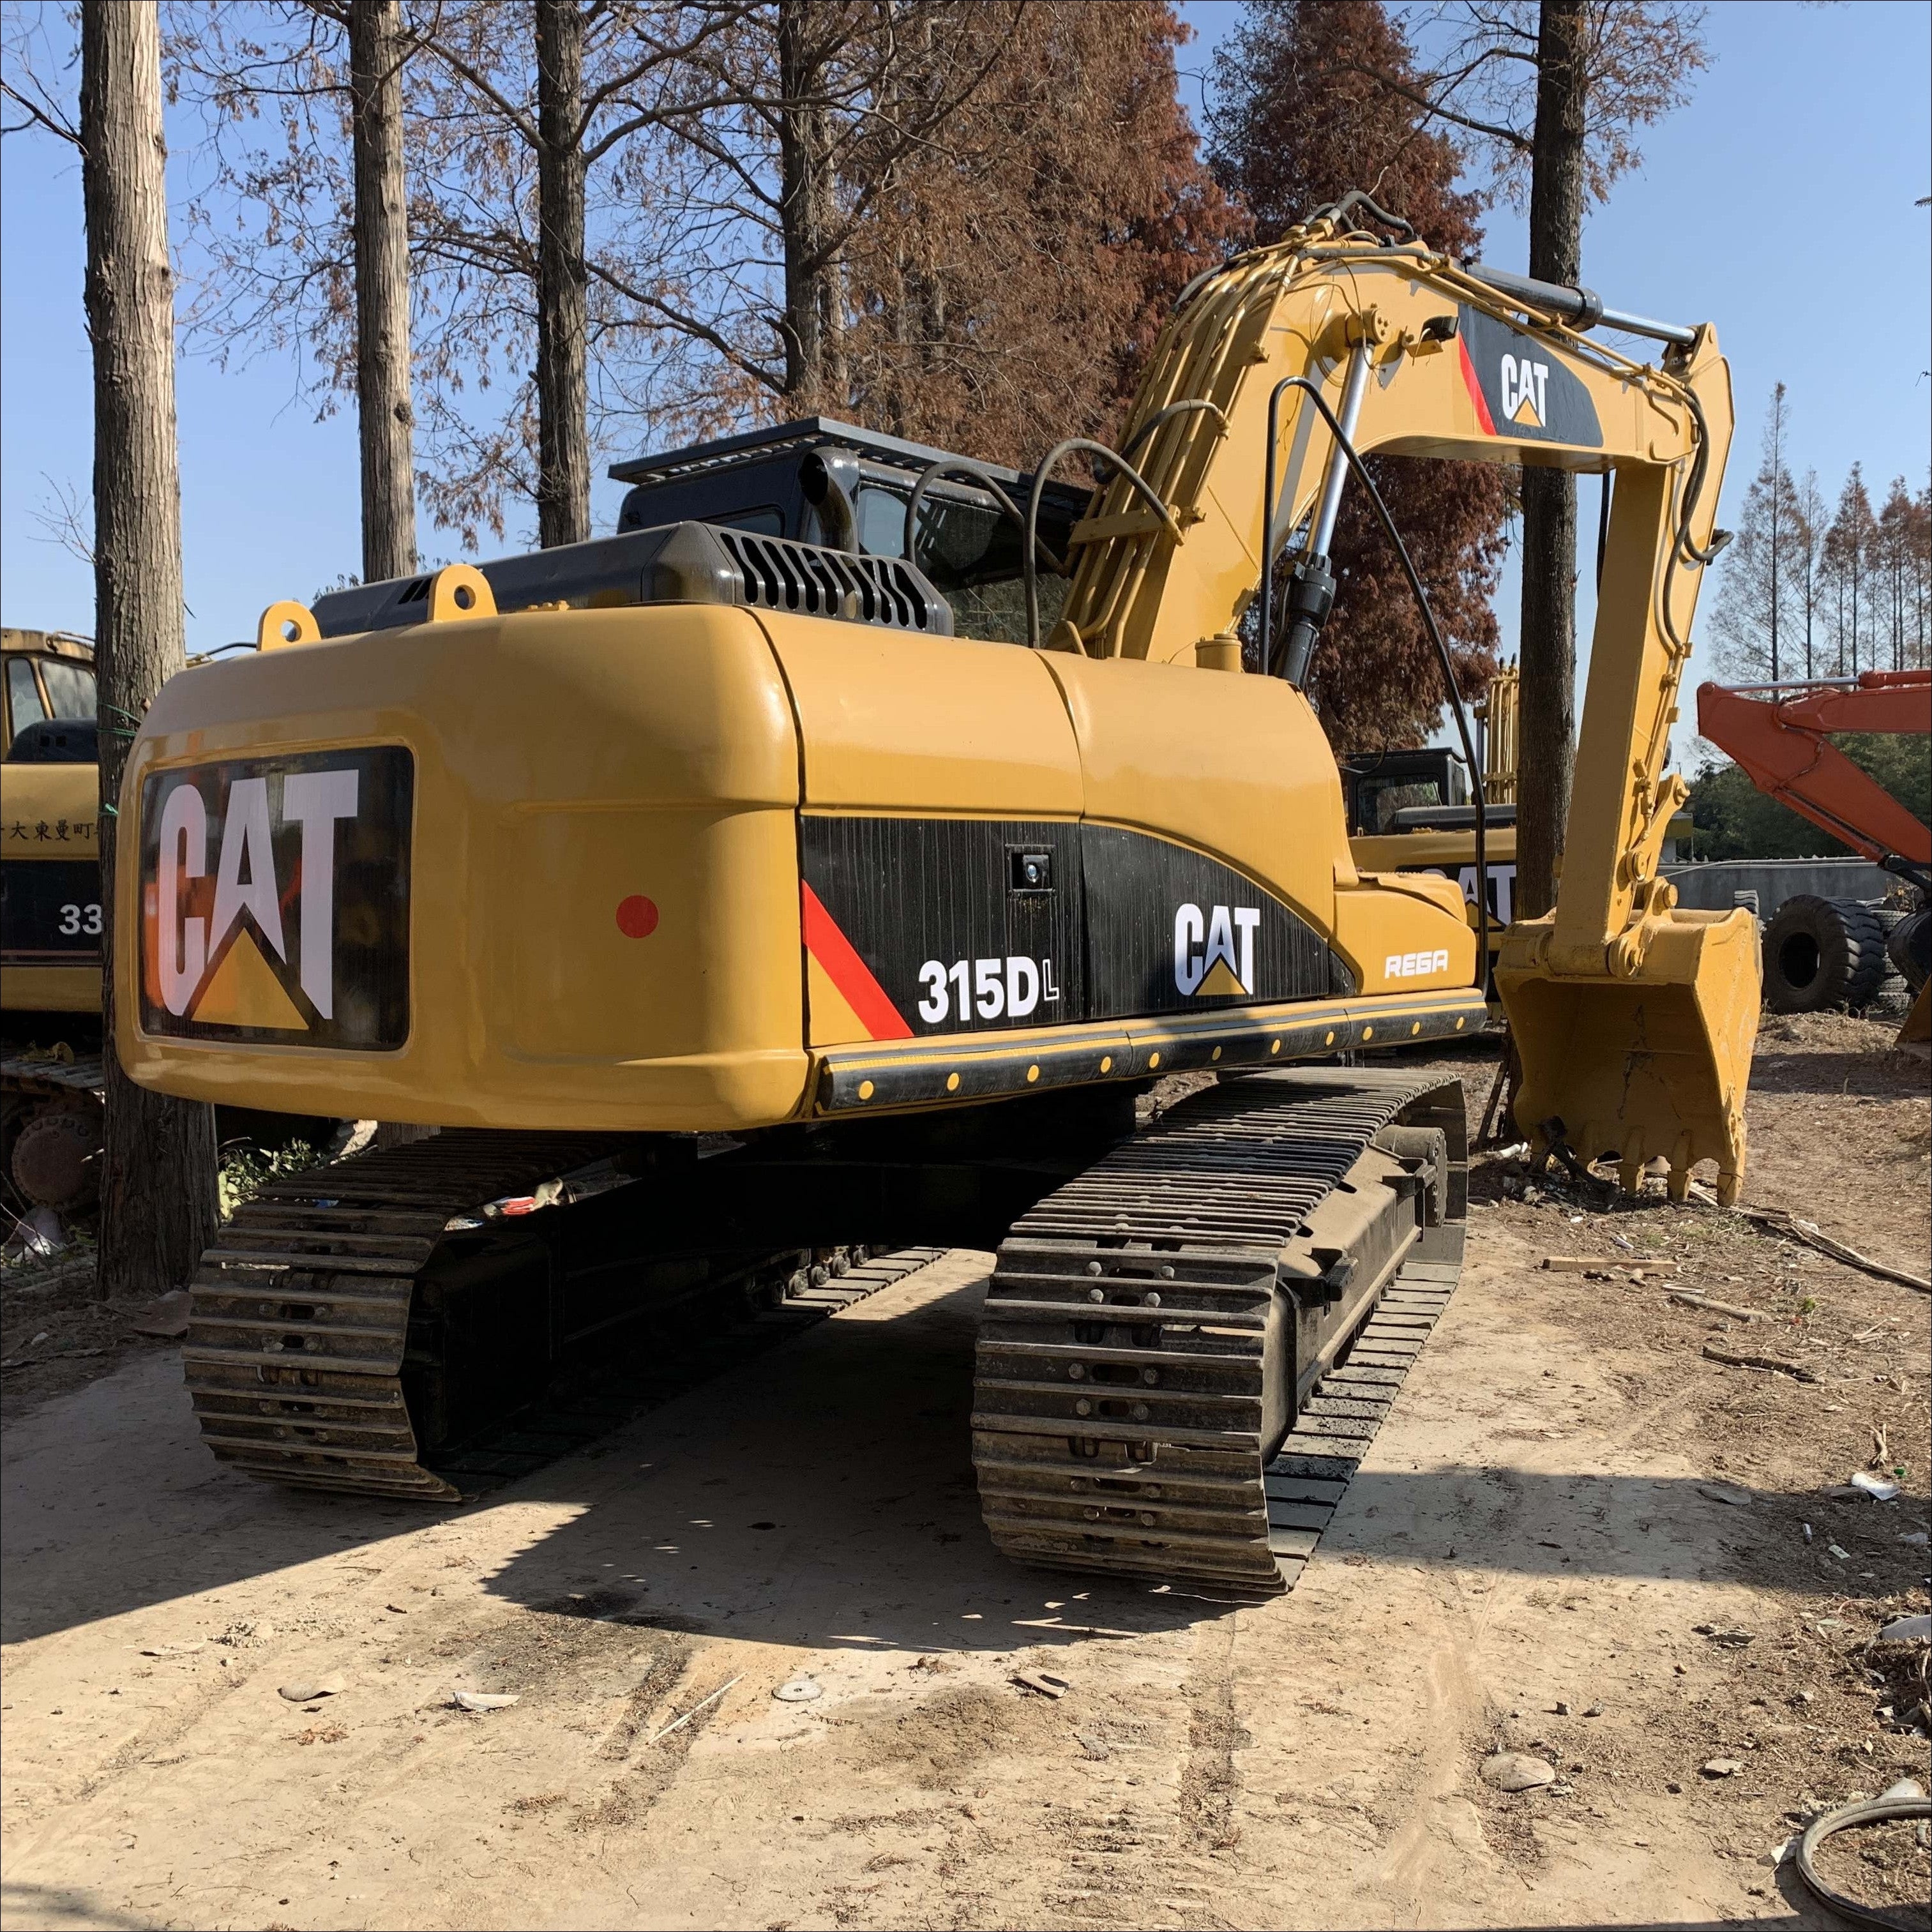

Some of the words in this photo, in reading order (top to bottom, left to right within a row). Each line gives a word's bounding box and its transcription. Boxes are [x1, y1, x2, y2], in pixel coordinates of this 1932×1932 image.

[1501, 354, 1548, 426] CAT
[158, 769, 359, 1020] CAT
[1421, 864, 1517, 926] AT
[1174, 903, 1261, 995] CAT
[1384, 949, 1448, 979] REGA
